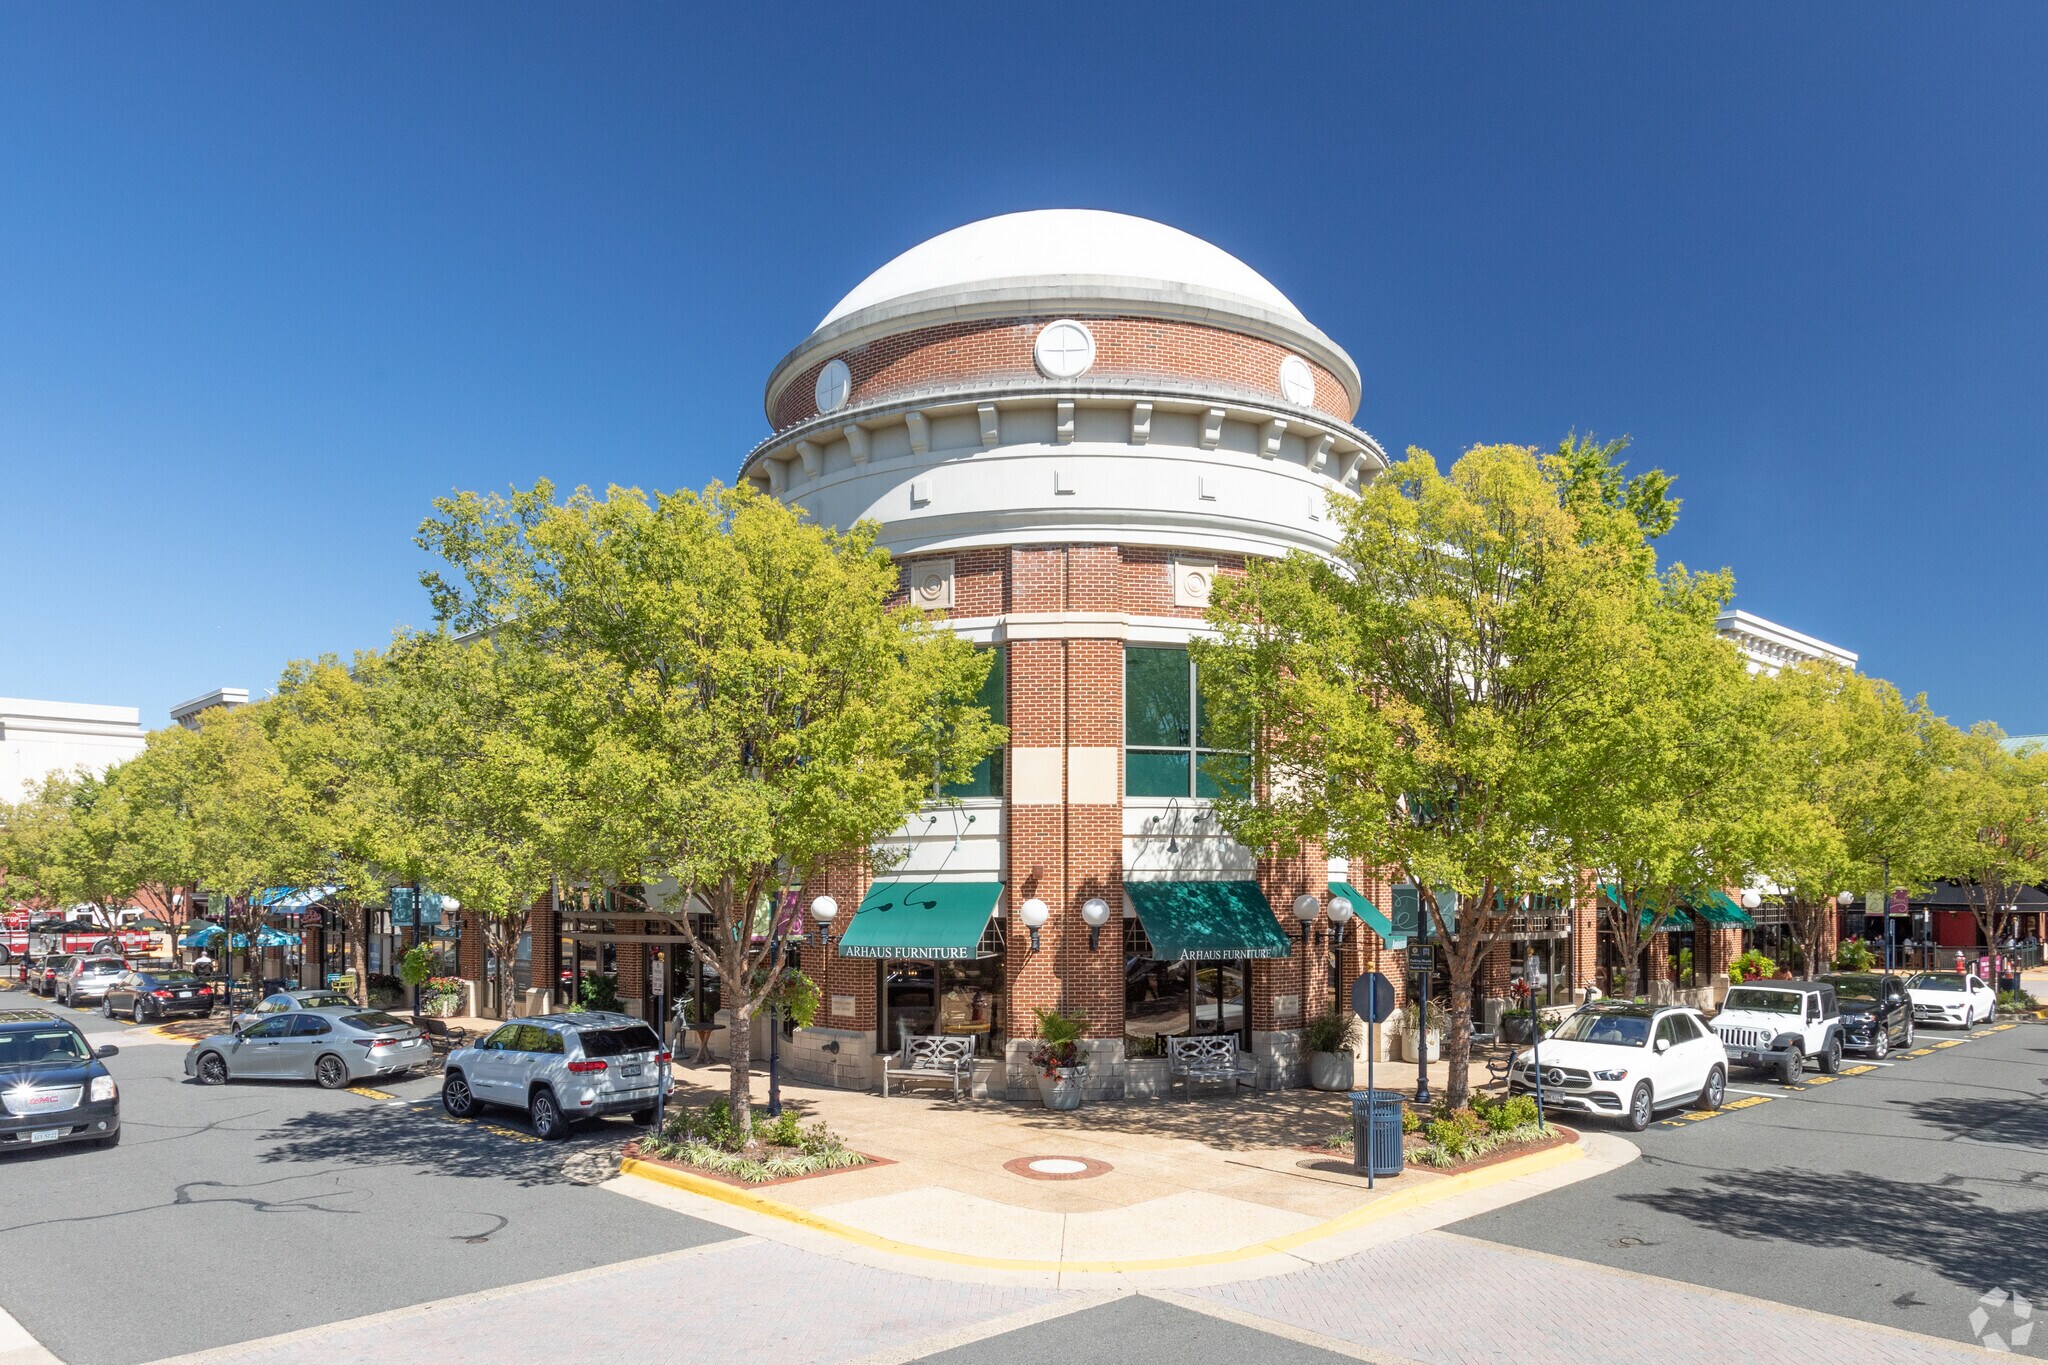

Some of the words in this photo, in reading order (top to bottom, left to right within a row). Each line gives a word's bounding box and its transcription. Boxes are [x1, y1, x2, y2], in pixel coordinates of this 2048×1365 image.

[846, 946, 892, 958] ARHAUS
[895, 947, 968, 959] FURNITURE
[1180, 948, 1221, 960] ARHAUS
[1223, 949, 1271, 959] FURNITURE
